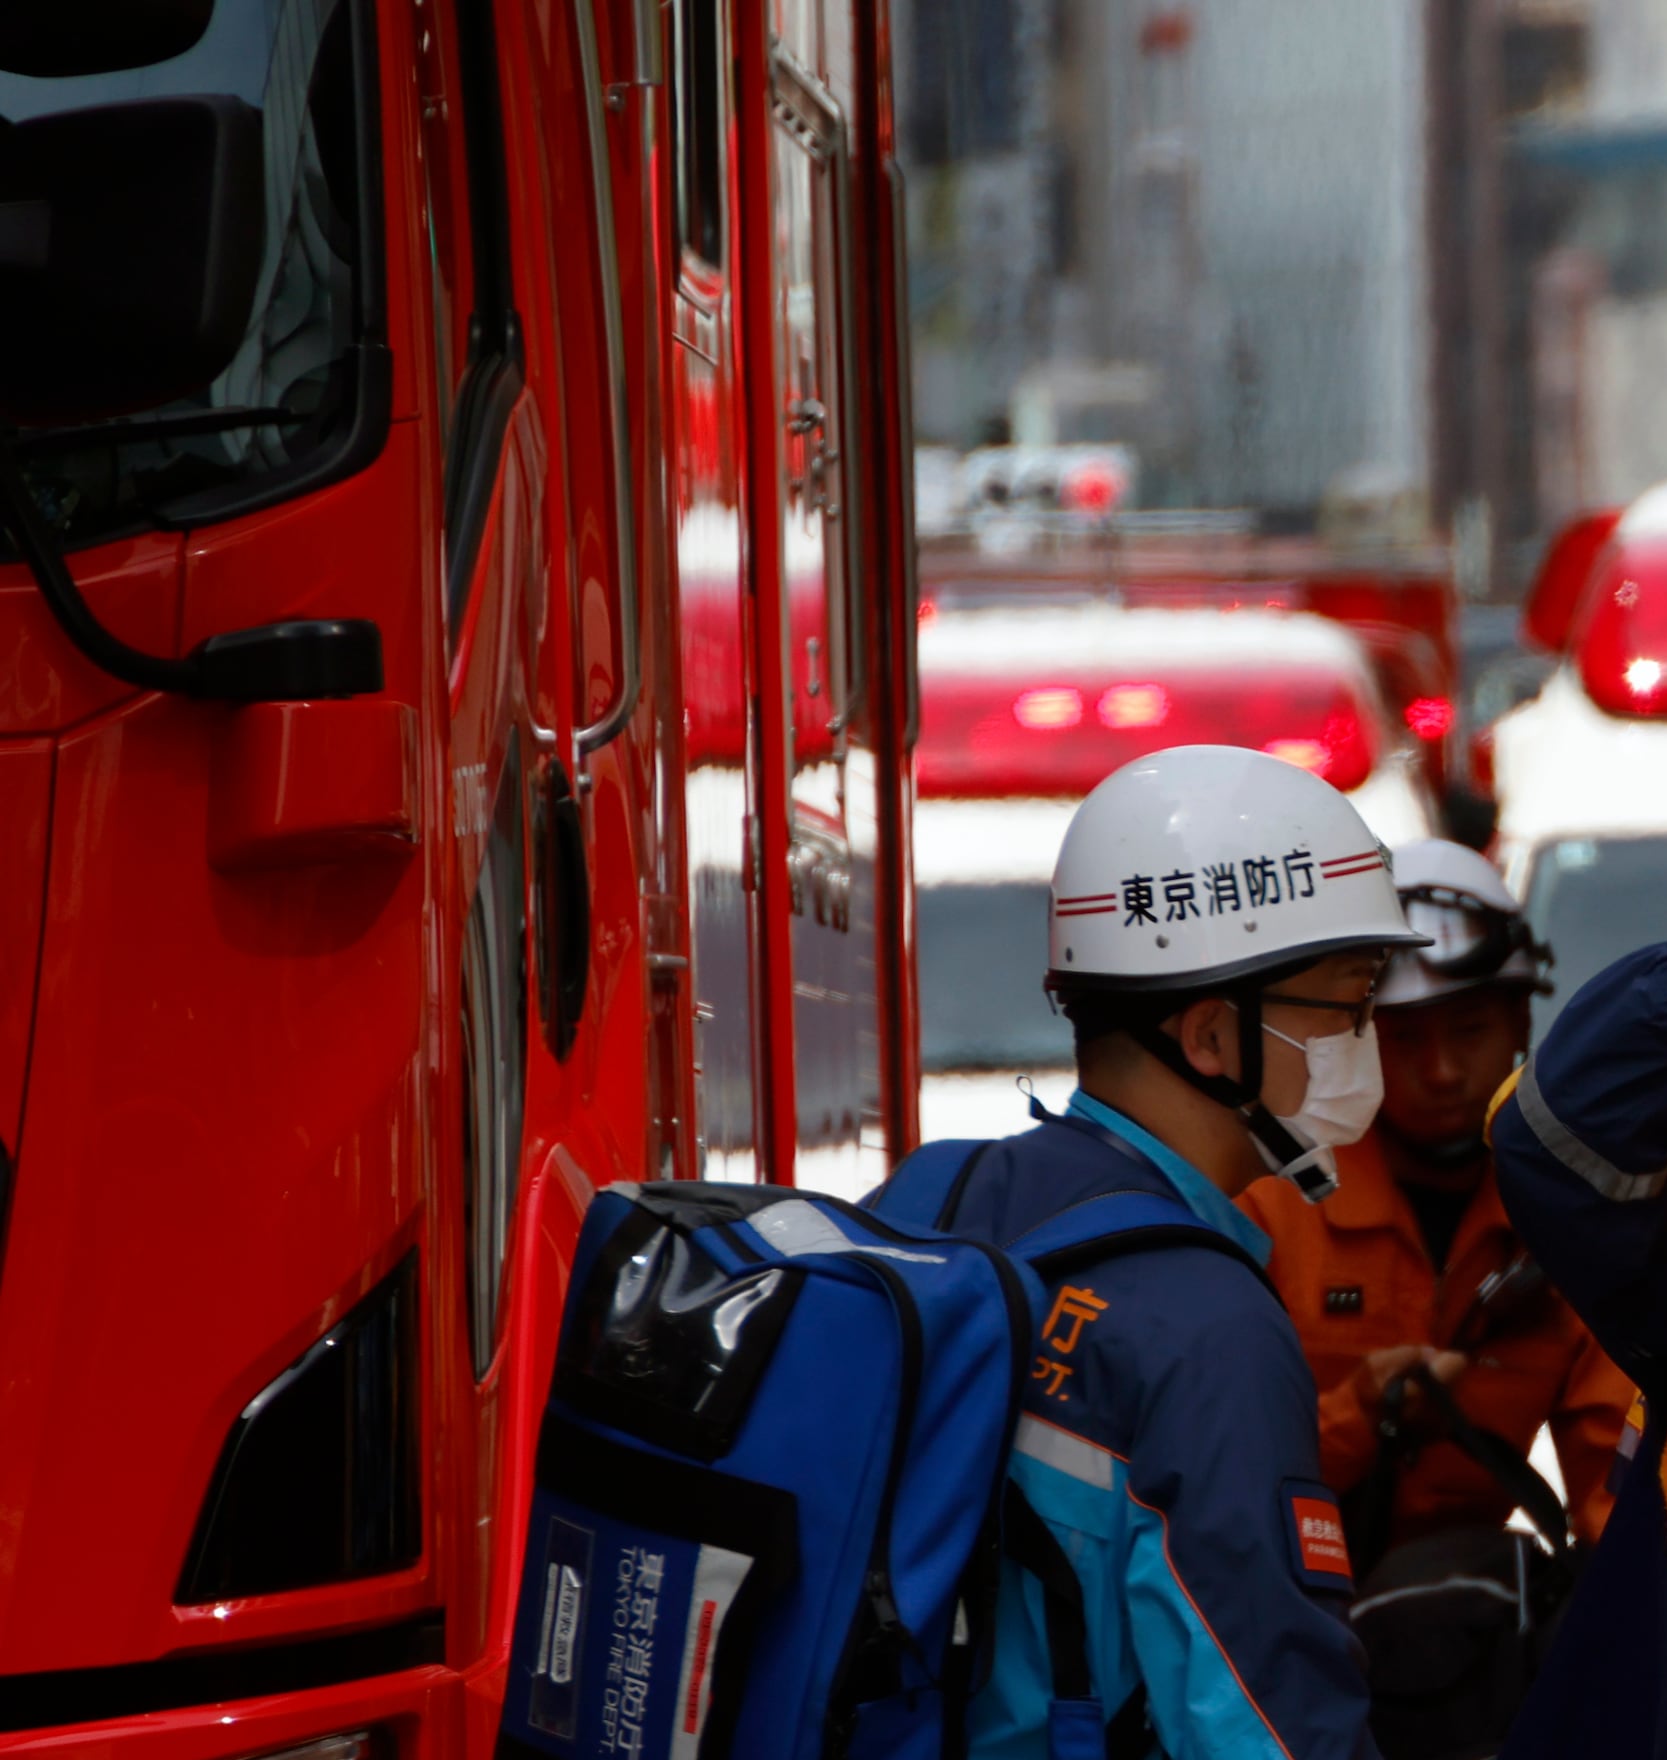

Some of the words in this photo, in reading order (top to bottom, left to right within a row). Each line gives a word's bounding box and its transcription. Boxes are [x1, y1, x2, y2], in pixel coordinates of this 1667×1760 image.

[1121, 849, 1315, 927] 東京消防庁
[612, 1547, 637, 1628] TOKYO
[606, 1632, 627, 1682] FIRE
[598, 1688, 620, 1753] DEPT.
